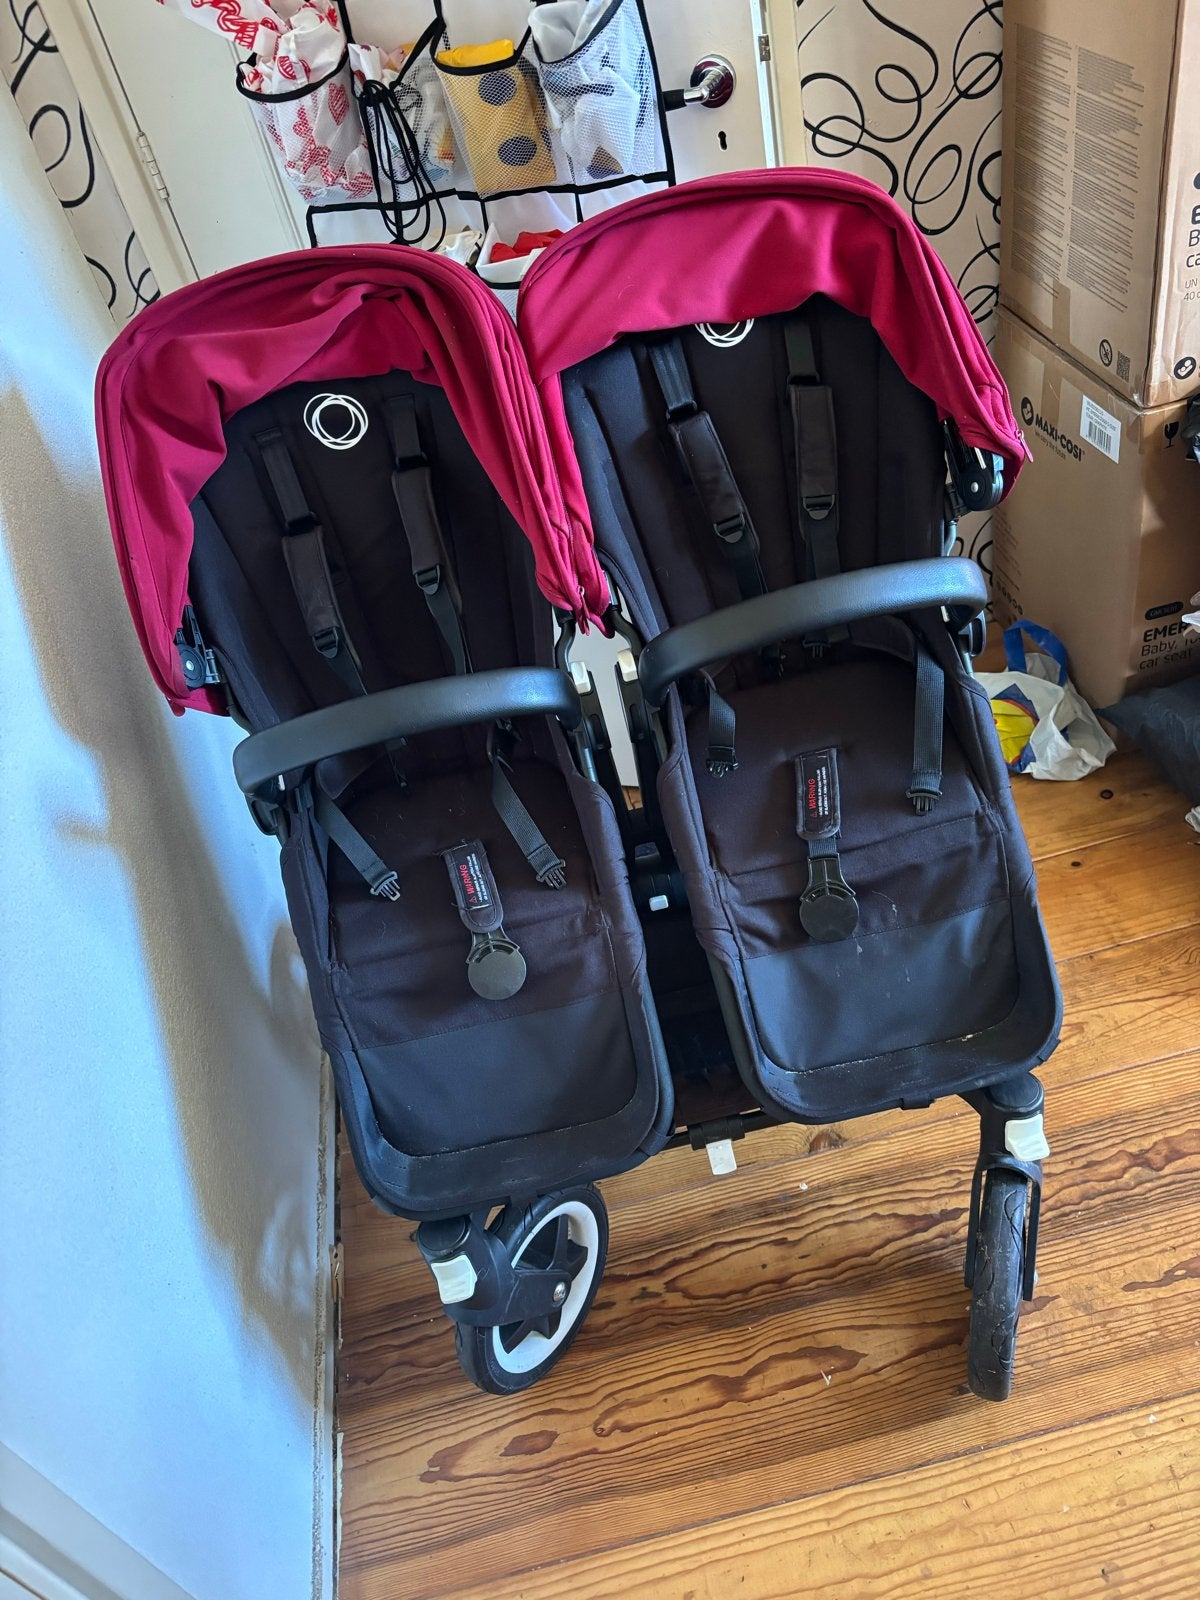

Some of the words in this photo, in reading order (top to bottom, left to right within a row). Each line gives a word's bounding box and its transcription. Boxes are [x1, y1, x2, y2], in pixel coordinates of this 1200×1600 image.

[1139, 656, 1160, 670] car
[808, 778, 816, 809] WARNING
[459, 864, 475, 894] WARNING
